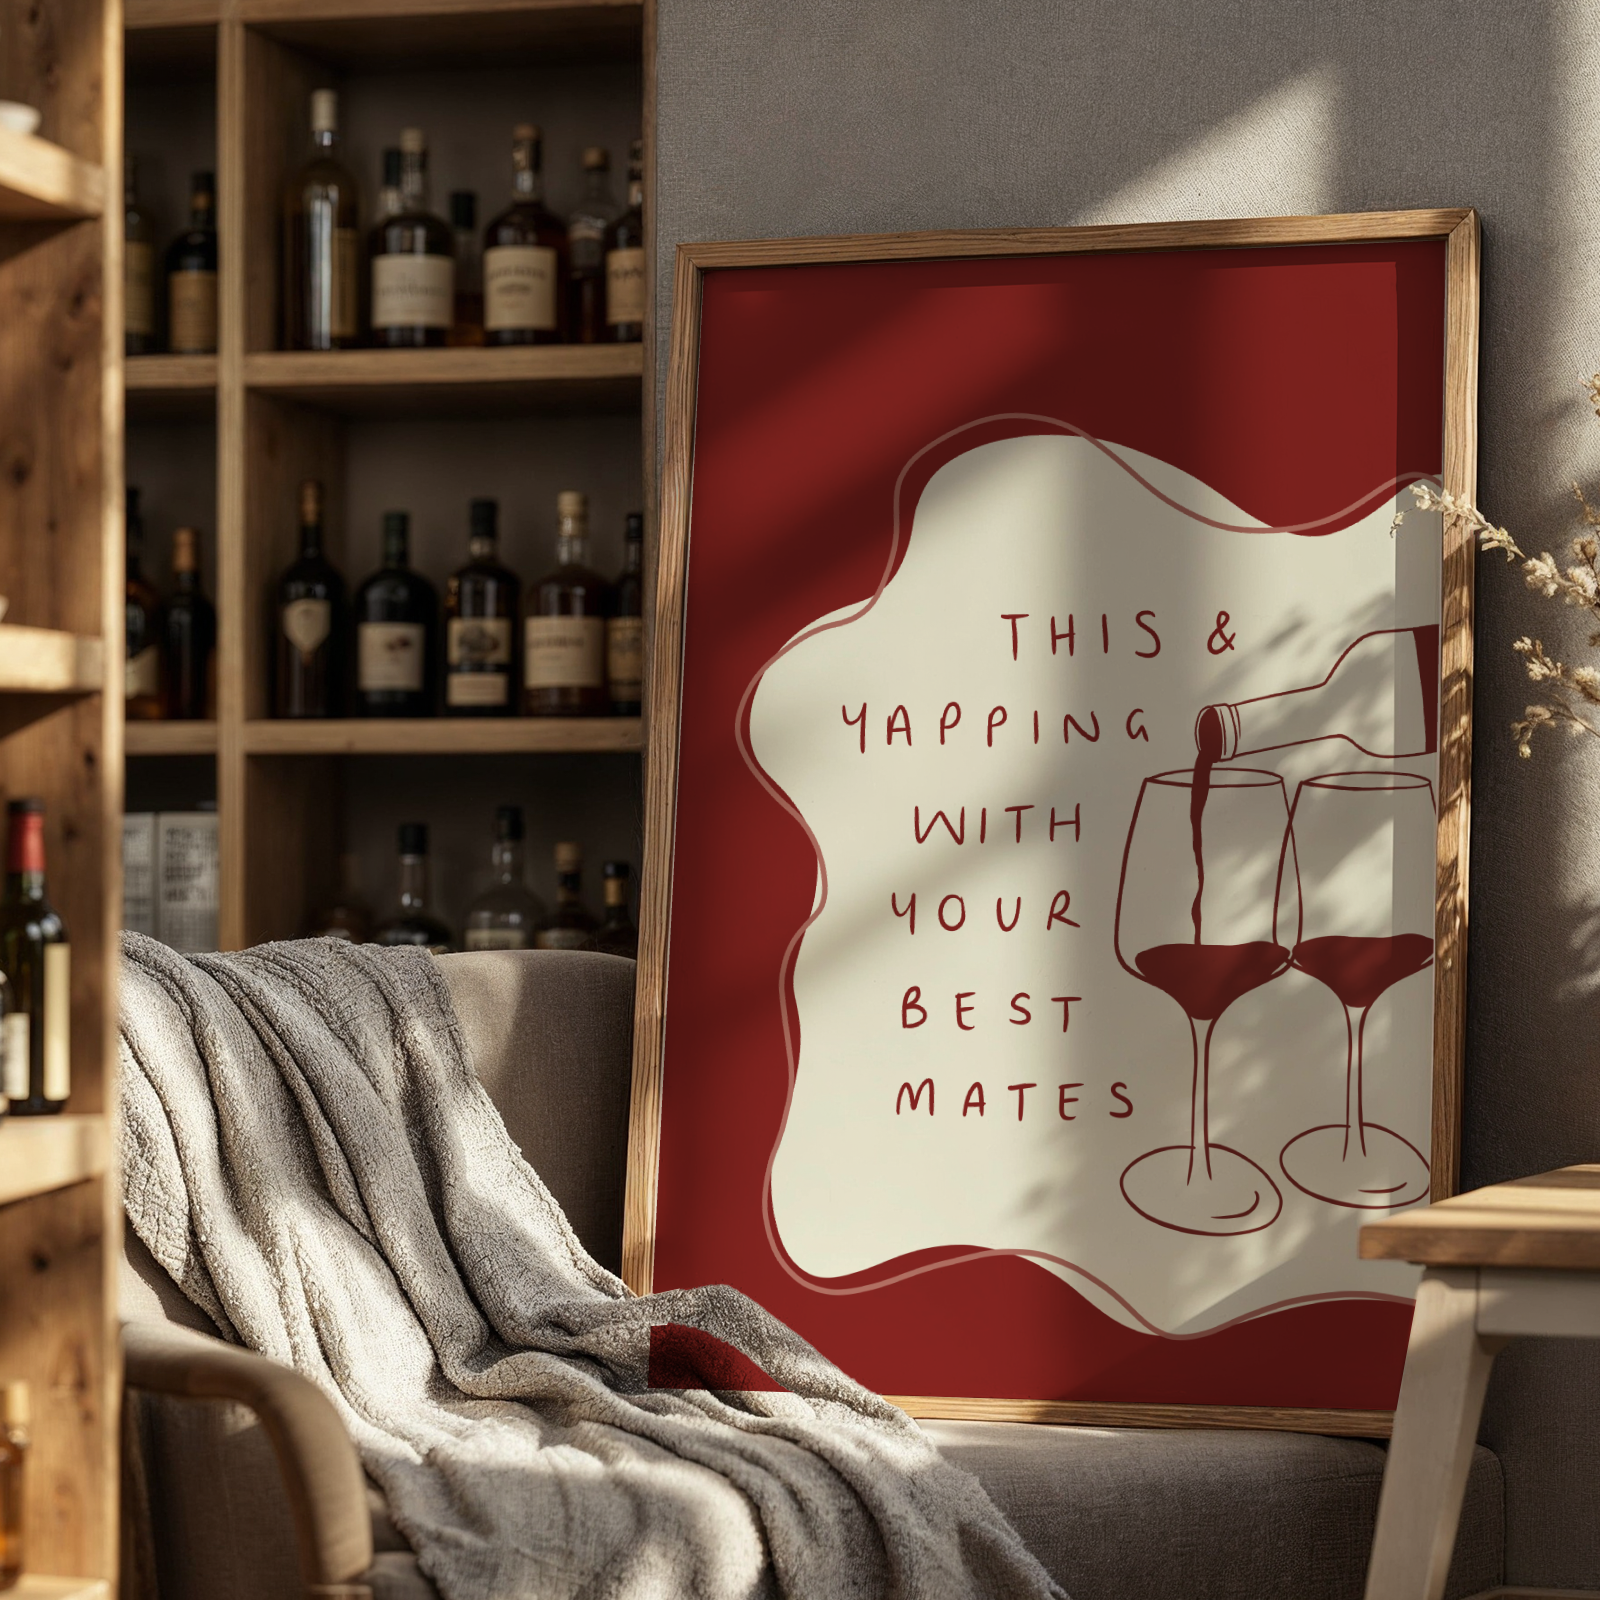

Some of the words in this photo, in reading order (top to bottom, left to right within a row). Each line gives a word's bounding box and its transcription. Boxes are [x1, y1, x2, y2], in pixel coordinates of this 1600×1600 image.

[1001, 611, 1160, 660] THIS
[1208, 611, 1235, 654] &
[842, 702, 1148, 753] YAPPING
[915, 803, 1080, 845] WITH
[892, 890, 1080, 934] YOUR
[902, 986, 1081, 1032] BEST
[896, 1078, 1133, 1121] MATES
